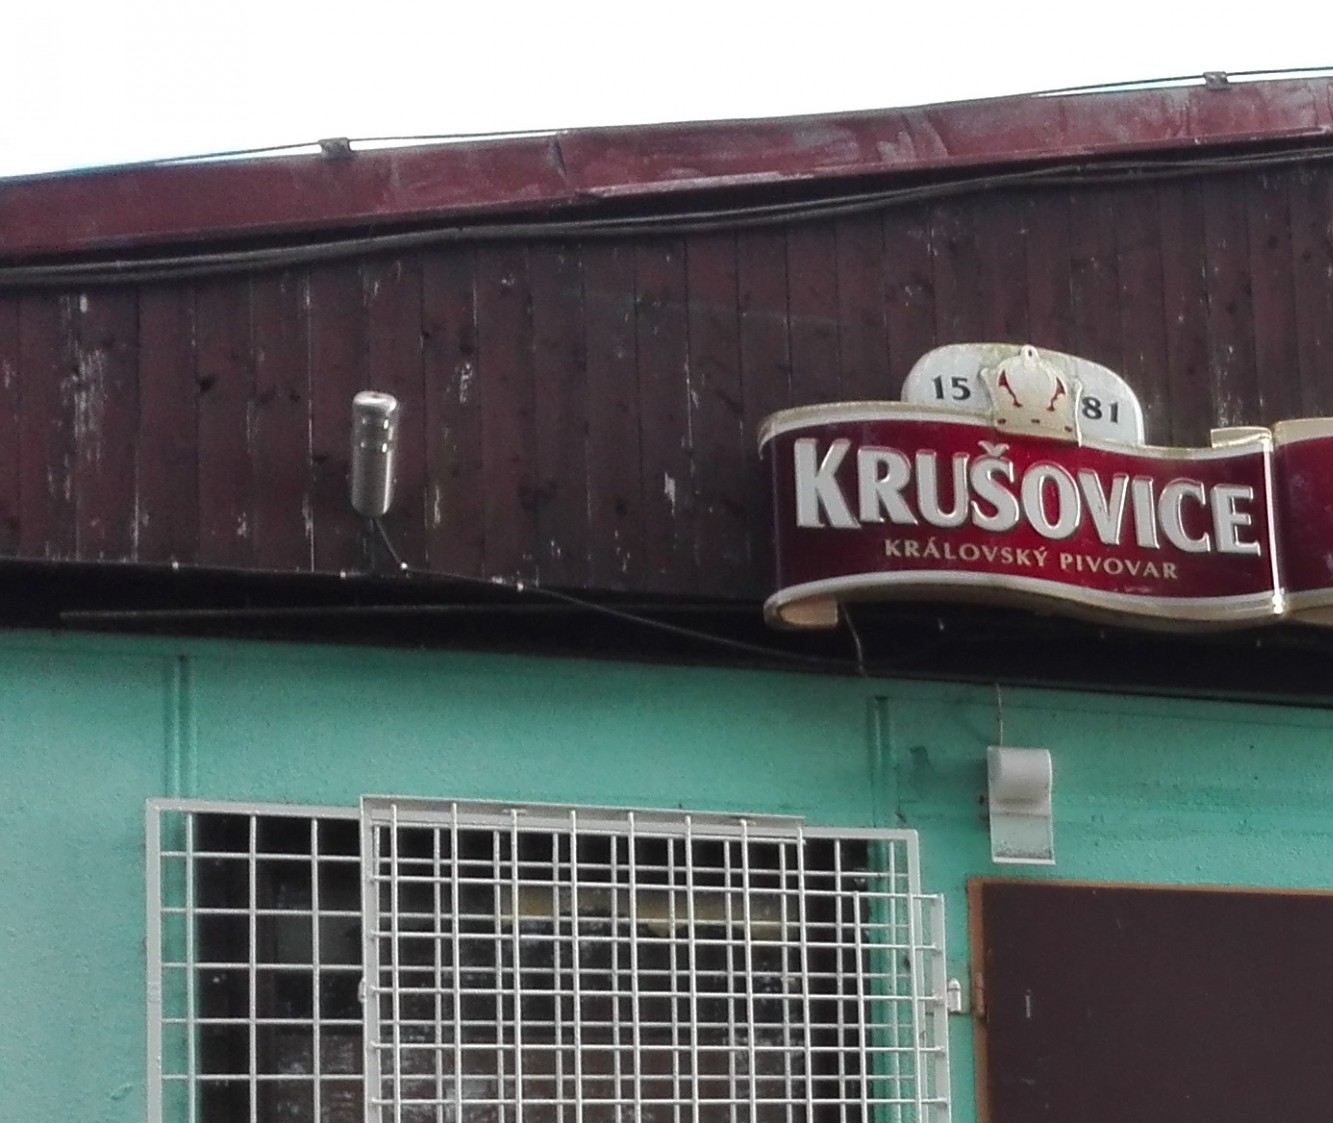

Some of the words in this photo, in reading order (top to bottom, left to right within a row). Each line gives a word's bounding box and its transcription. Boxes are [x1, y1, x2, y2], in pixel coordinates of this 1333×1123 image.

[931, 375, 971, 402] 15
[1081, 396, 1121, 423] 81
[793, 437, 1262, 557] KRUŠOVICE
[885, 534, 1048, 569] KRÁLOVSKÝ
[1060, 552, 1179, 581] PIVOVAR
